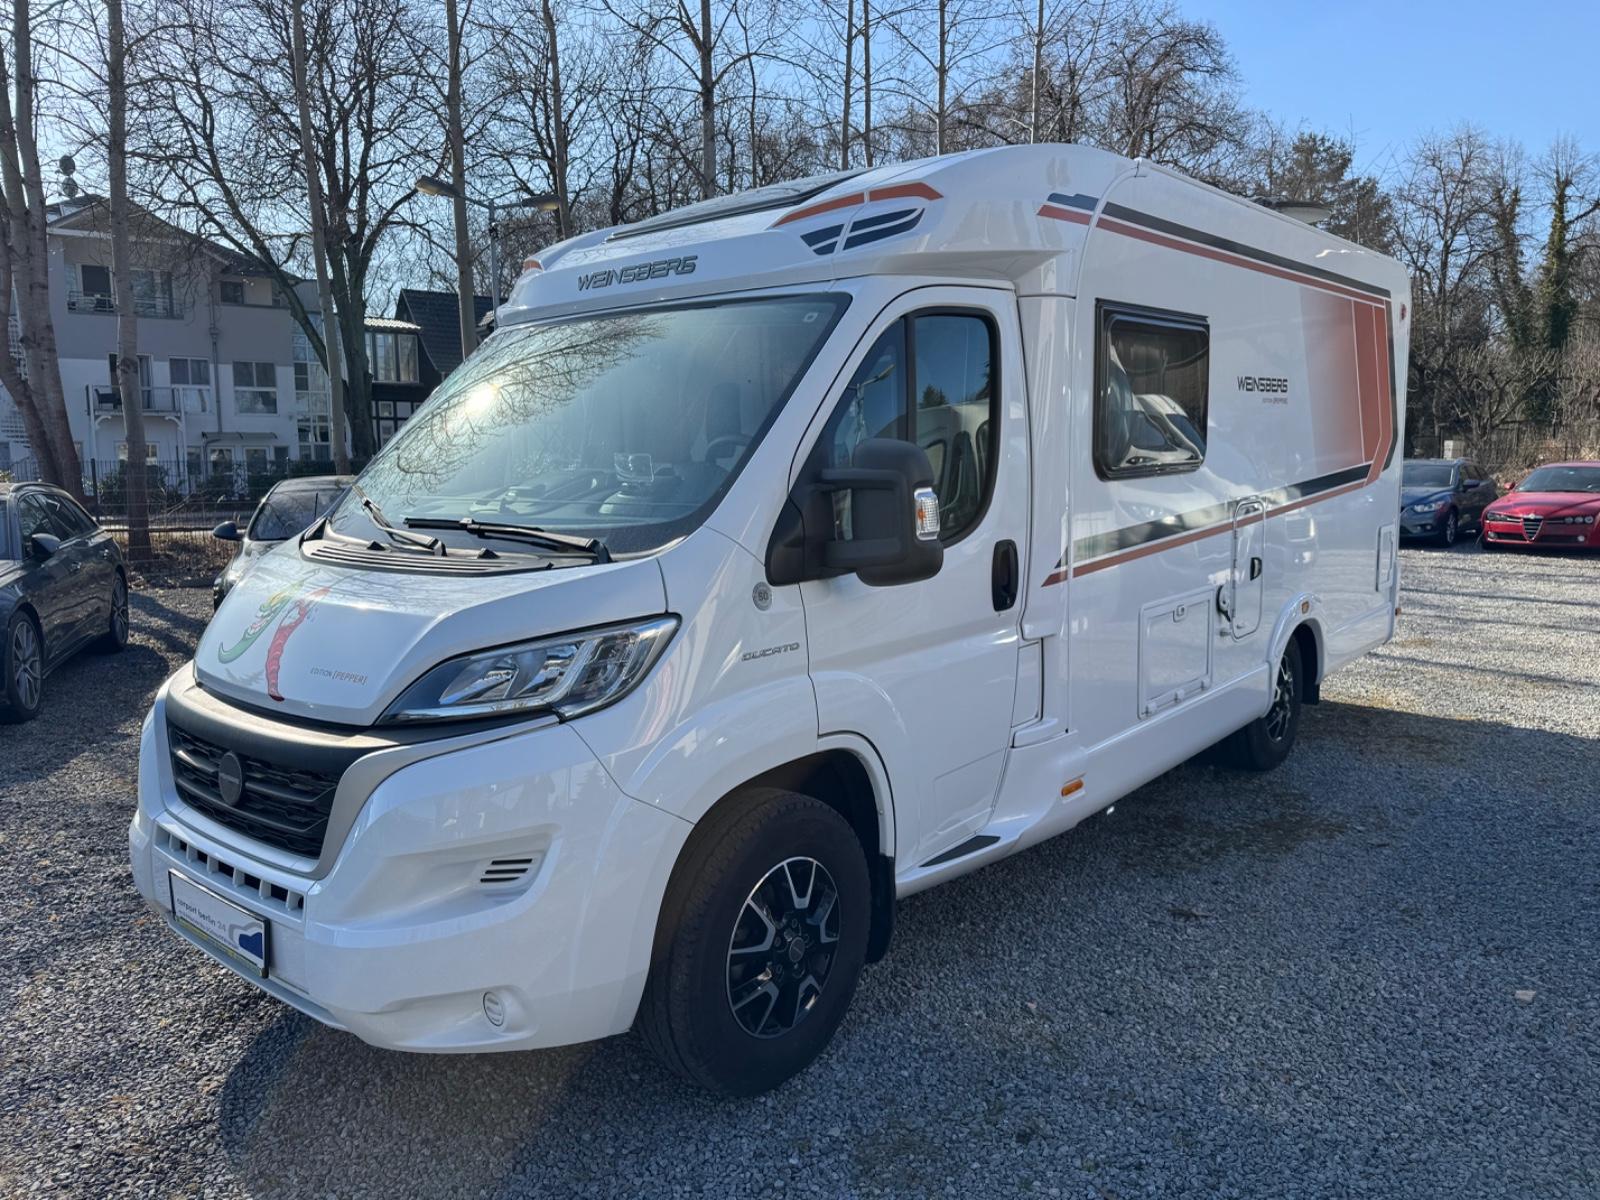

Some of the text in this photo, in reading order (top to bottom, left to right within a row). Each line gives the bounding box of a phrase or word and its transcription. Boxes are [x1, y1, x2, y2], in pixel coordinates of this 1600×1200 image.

[578, 255, 698, 291] WEINSBERG
[1237, 376, 1288, 393] WEINSBERG
[742, 642, 800, 661] DUCATO
